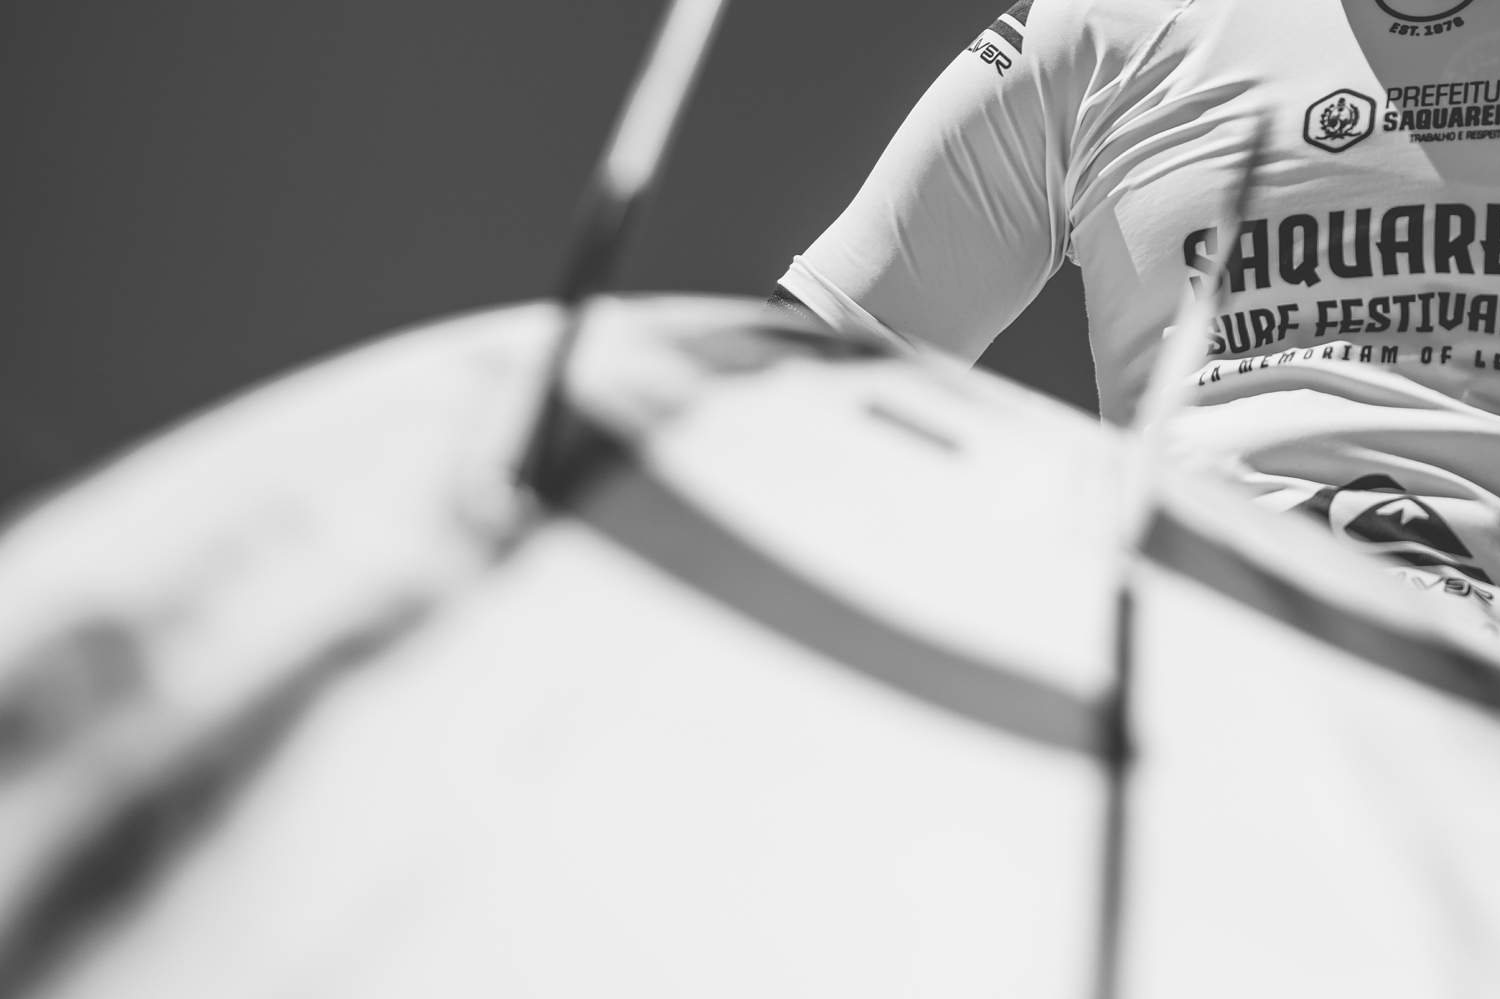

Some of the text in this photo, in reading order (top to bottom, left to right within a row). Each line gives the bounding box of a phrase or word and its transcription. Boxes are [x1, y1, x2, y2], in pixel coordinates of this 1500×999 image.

[1389, 17, 1465, 36] EST. 1976
[1410, 132, 1456, 143] TRABALHO
[1458, 131, 1464, 140] E
[1206, 303, 1300, 356] SURF
[1238, 344, 1399, 375] MEMORIAM
[1421, 345, 1453, 364] OF
